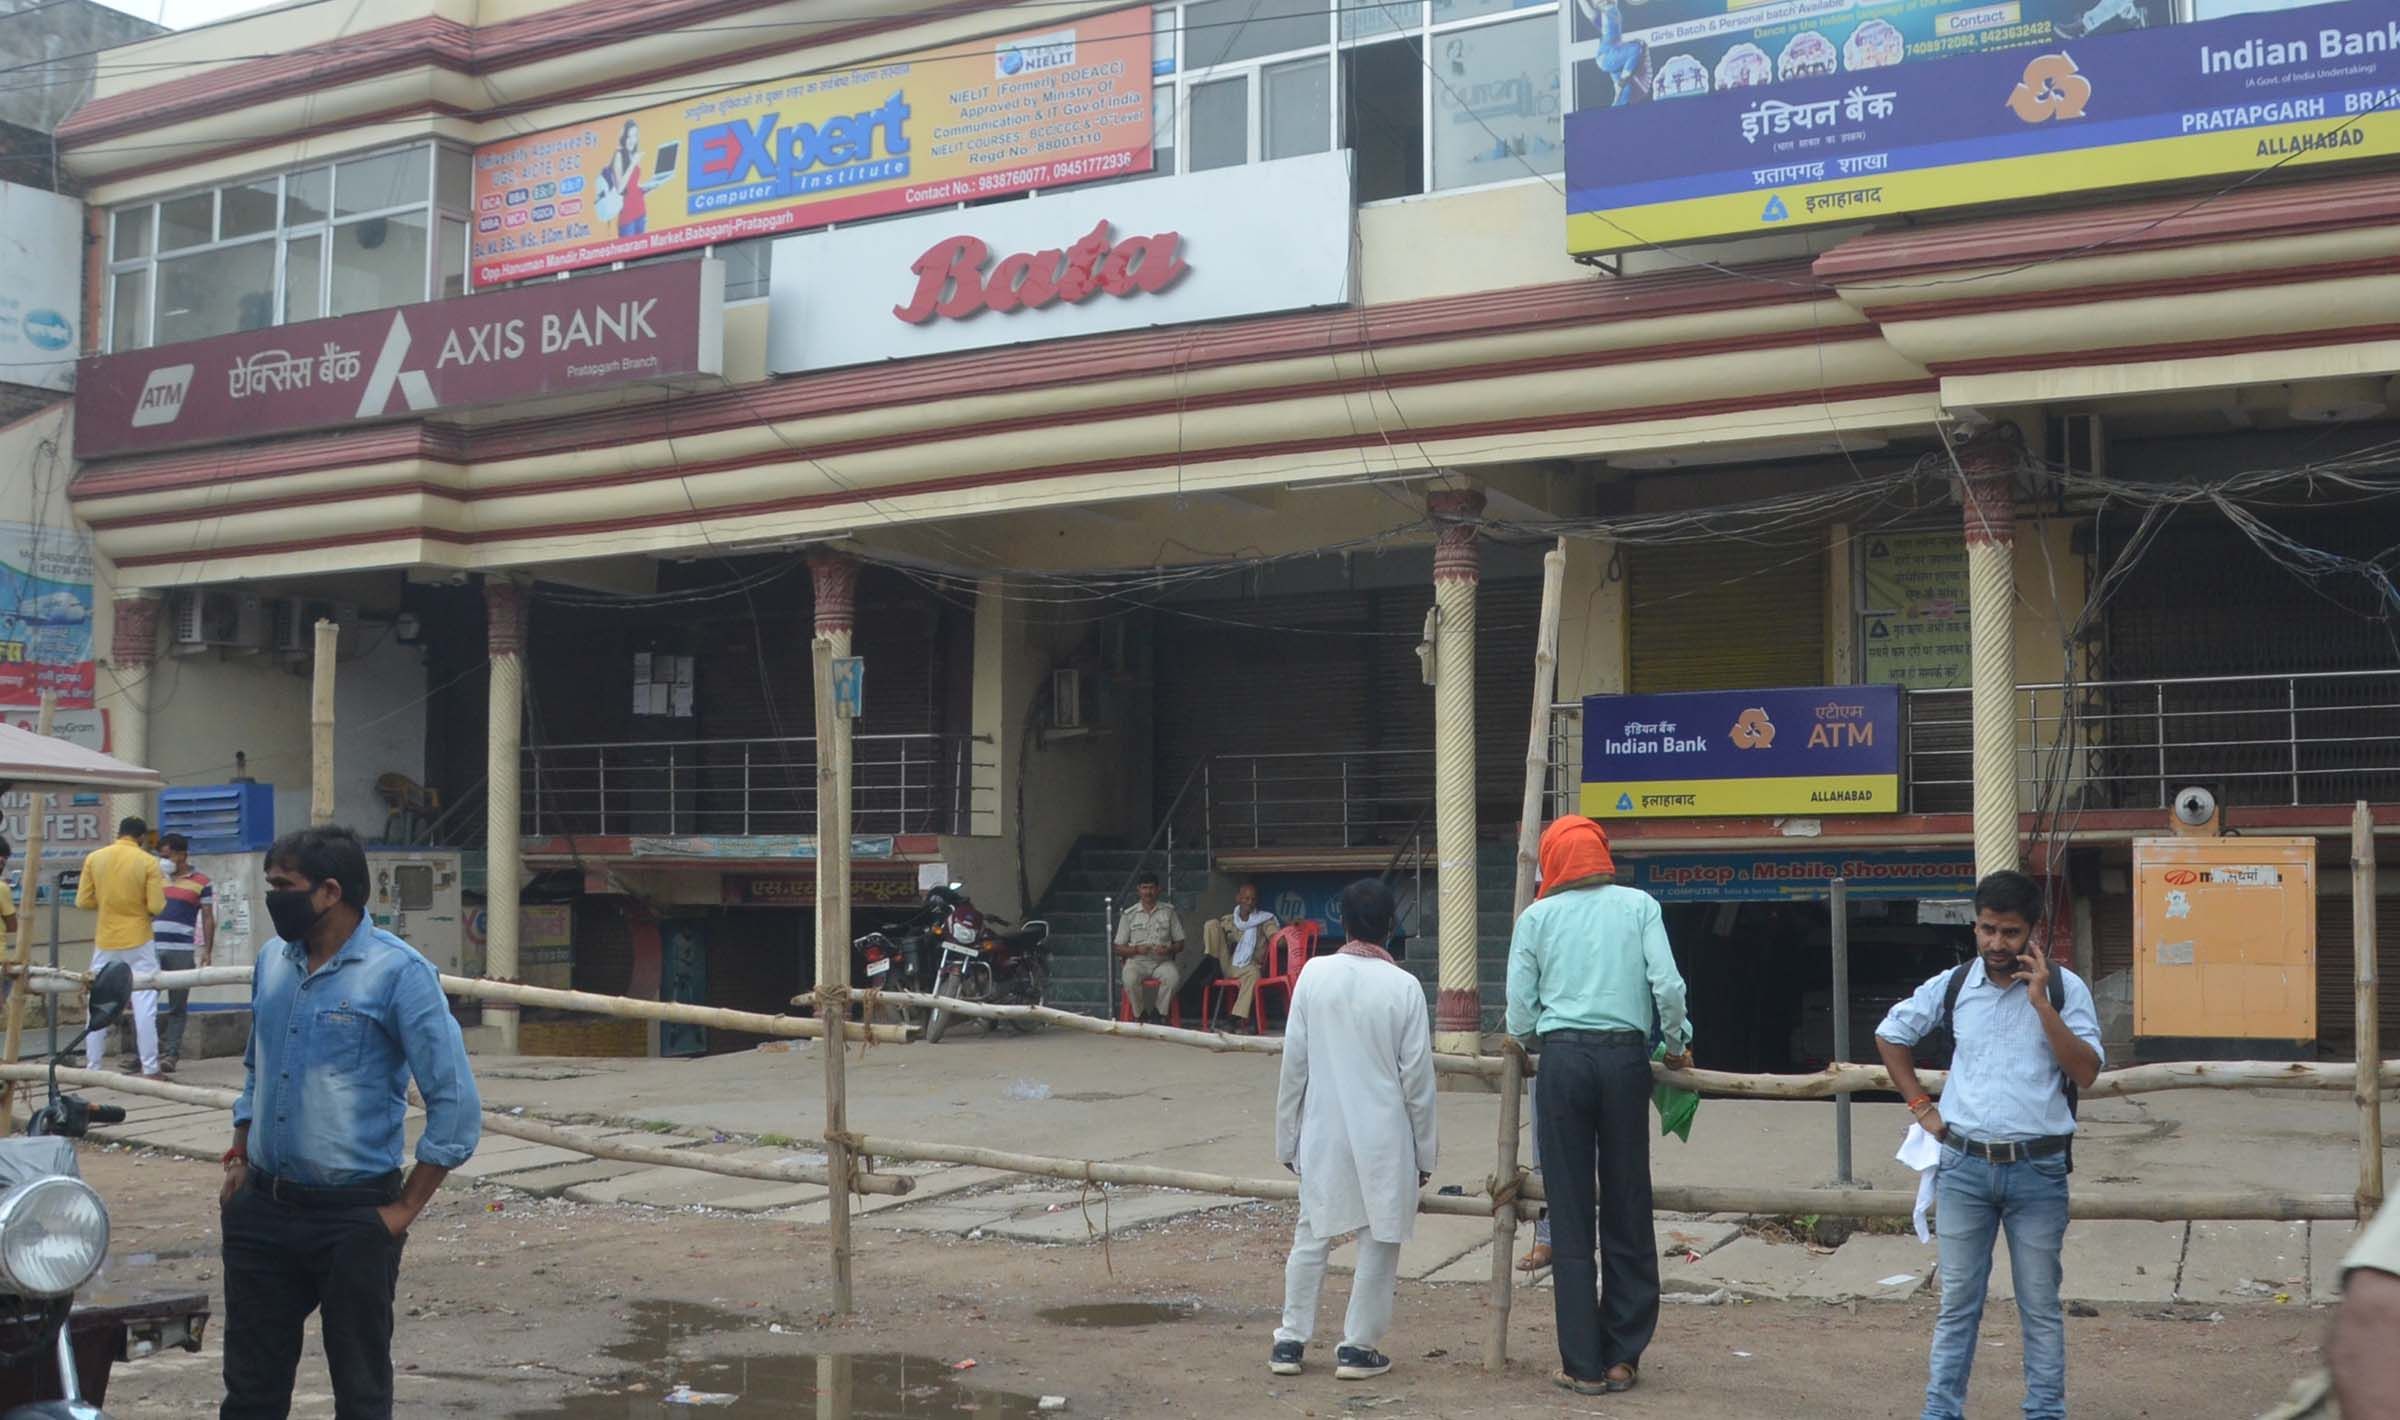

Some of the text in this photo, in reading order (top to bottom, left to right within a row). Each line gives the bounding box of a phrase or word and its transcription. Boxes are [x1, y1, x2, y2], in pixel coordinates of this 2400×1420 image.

[1676, 23, 1706, 38] Batch
[1719, 11, 1764, 30] Personal
[1766, 5, 1796, 22] batch
[1950, 10, 2005, 29] Contact
[1025, 50, 1073, 71] NIELIT
[2201, 20, 2400, 74] Indian Bank
[949, 60, 1124, 105] NIELIT (Formerly DOEACC)
[2282, 73, 2292, 84] of
[2293, 70, 2316, 82] India
[2317, 62, 2377, 81] Undertaking)
[960, 80, 1113, 120] Approved by Ministry Of
[1740, 85, 1898, 144] इंडियन बैंक
[933, 112, 1031, 140] Communication
[1034, 110, 1044, 122] &
[1047, 107, 1058, 119] IT
[1108, 92, 1142, 110] India
[2181, 97, 2326, 133] PRATAPGARH
[930, 141, 966, 158] NIELIT
[2255, 128, 2365, 158] ALLAHABAD
[905, 182, 951, 204] Contact
[1053, 151, 1132, 178] 09451772936
[1752, 152, 1889, 186] प्रतापगढ़ शाखा
[694, 162, 905, 209] Computer Institute
[1805, 186, 1884, 214] इलाहाबाद
[892, 218, 1188, 325] Bata
[436, 298, 659, 369] AXIS BANK
[228, 341, 361, 399] ऐक्सिस बैंक
[566, 354, 658, 378] Pratapgarh Branch
[140, 383, 183, 411] ATM
[1815, 702, 1865, 721] एटीएम
[1623, 719, 1677, 737] इंडियन बैंक
[1807, 721, 1874, 749] ATM
[1605, 735, 1708, 756] Indian Bank
[1641, 793, 1697, 809] इलाहाबाद
[1810, 790, 1873, 804] ALLAHABAD
[1650, 865, 1734, 886] Laptop
[1752, 861, 1836, 880] Mobile
[1842, 860, 1976, 880] Showroom
